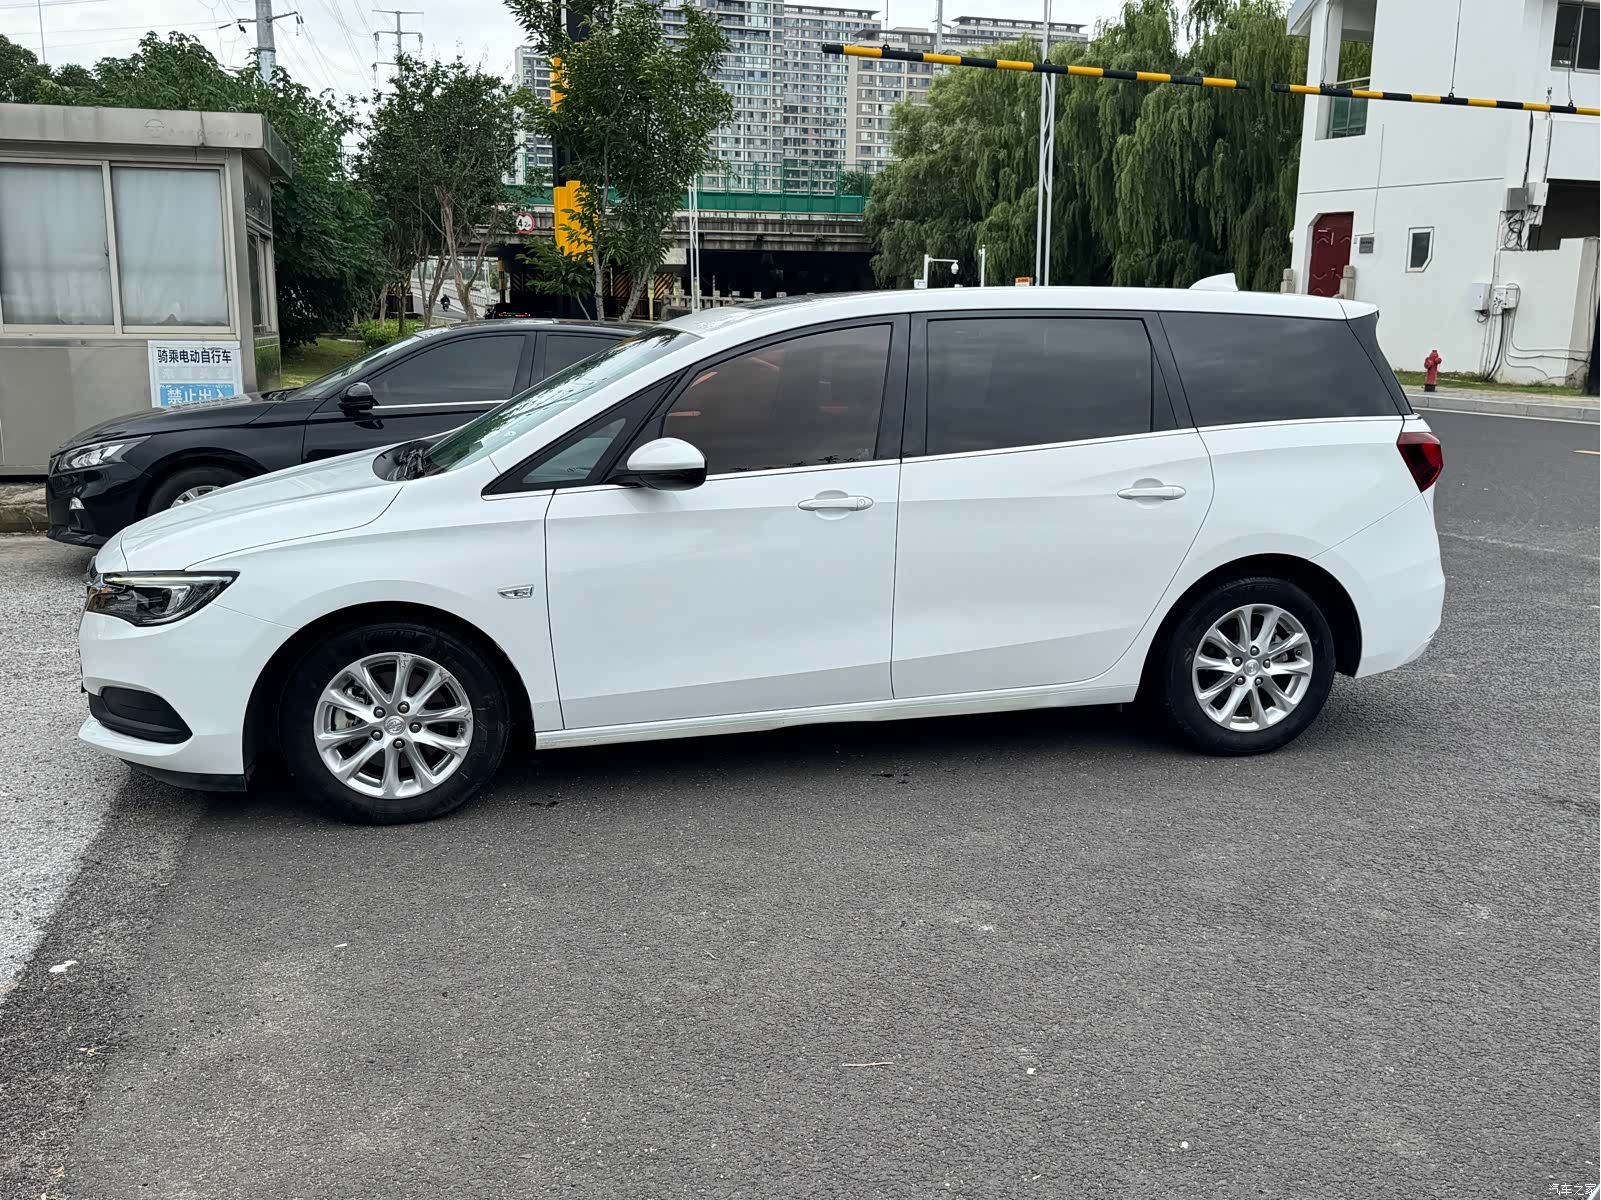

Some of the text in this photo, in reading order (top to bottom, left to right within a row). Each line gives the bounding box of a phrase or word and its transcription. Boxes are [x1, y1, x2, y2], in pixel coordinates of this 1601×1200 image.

[157, 349, 232, 364] 骑乘电动自行车
